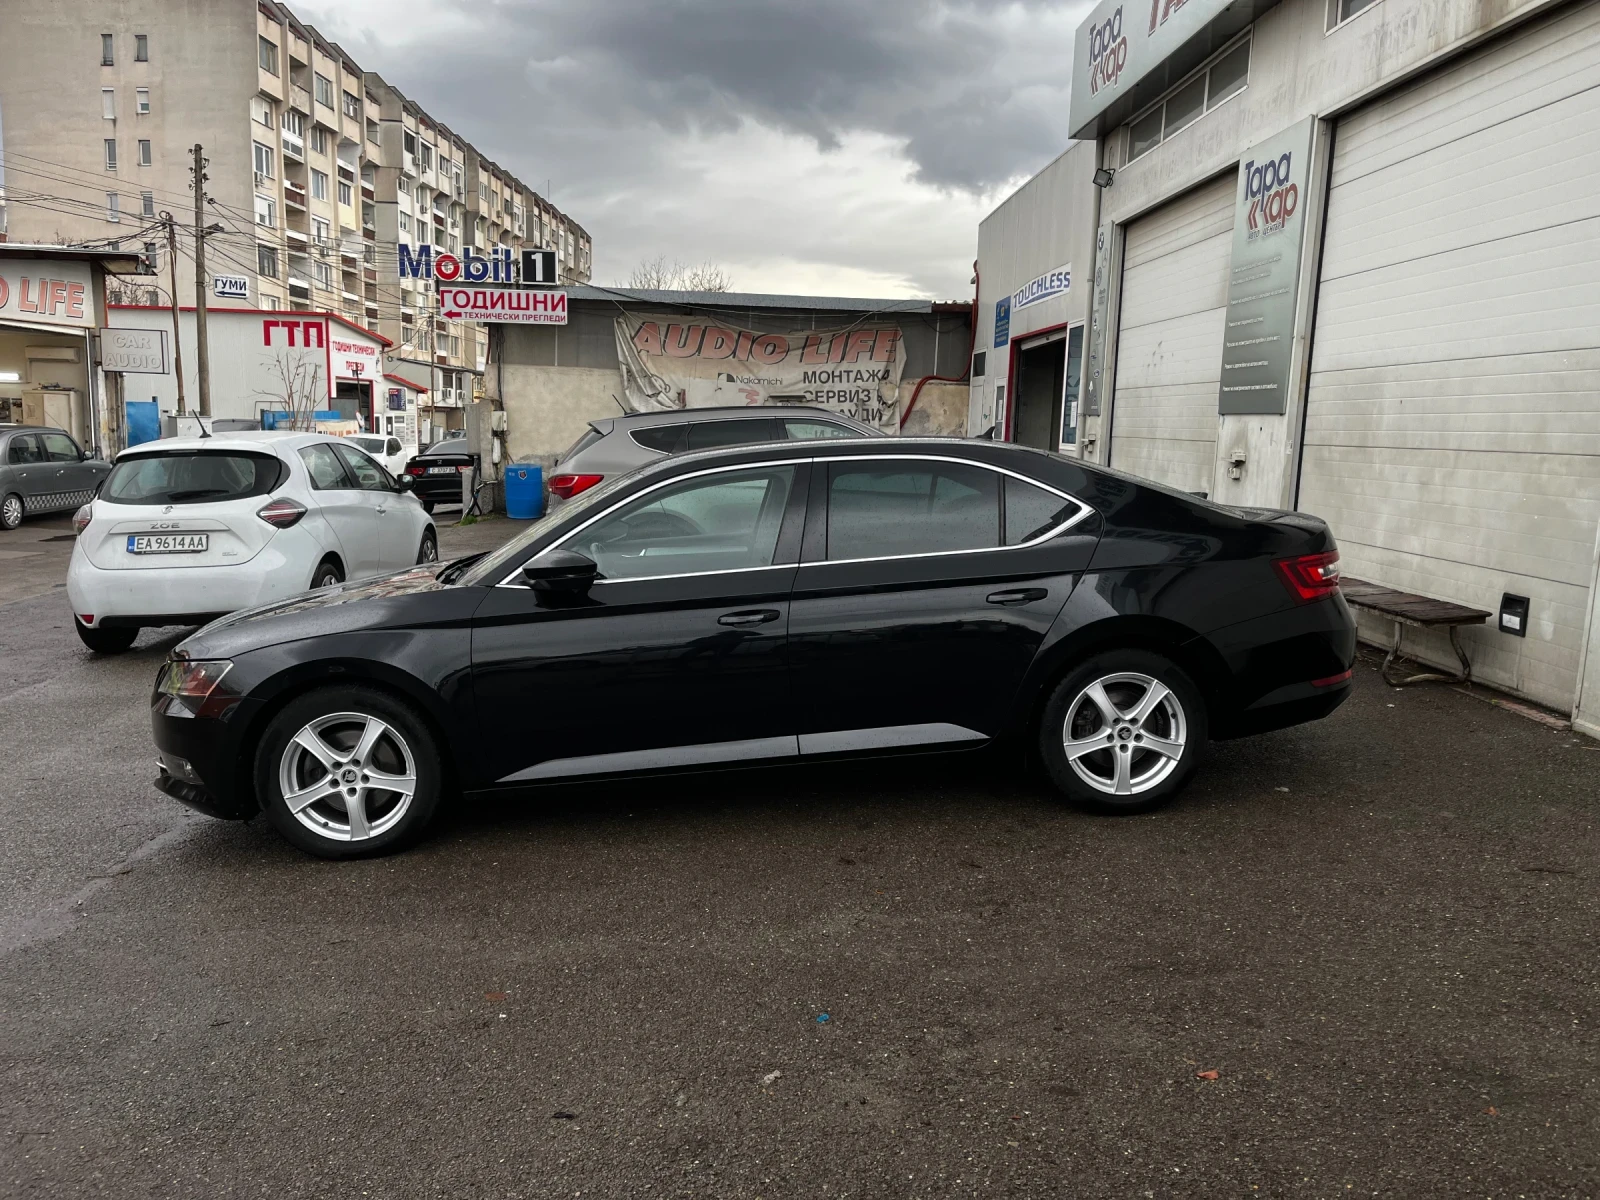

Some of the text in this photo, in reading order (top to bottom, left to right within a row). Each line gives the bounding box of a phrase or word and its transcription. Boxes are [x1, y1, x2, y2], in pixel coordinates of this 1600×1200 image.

[398, 243, 544, 283] Mobil 1
[214, 278, 247, 292] ГУМИ
[1013, 271, 1071, 309] TOUCHLESS
[18, 276, 85, 318] LIFE
[440, 289, 566, 312] ГОДИШНИ
[463, 311, 566, 322] ТЕХНИЧЕСКИ ПРЕГЛЕДИ
[112, 333, 151, 349] CAR
[262, 319, 324, 348] ГТП
[633, 321, 903, 365] AUDIO LIFE
[104, 352, 162, 369] AUDIO
[735, 375, 784, 387] Nakamichi
[150, 522, 181, 530] ZOE
[136, 536, 204, 550] EA 9614 AA
